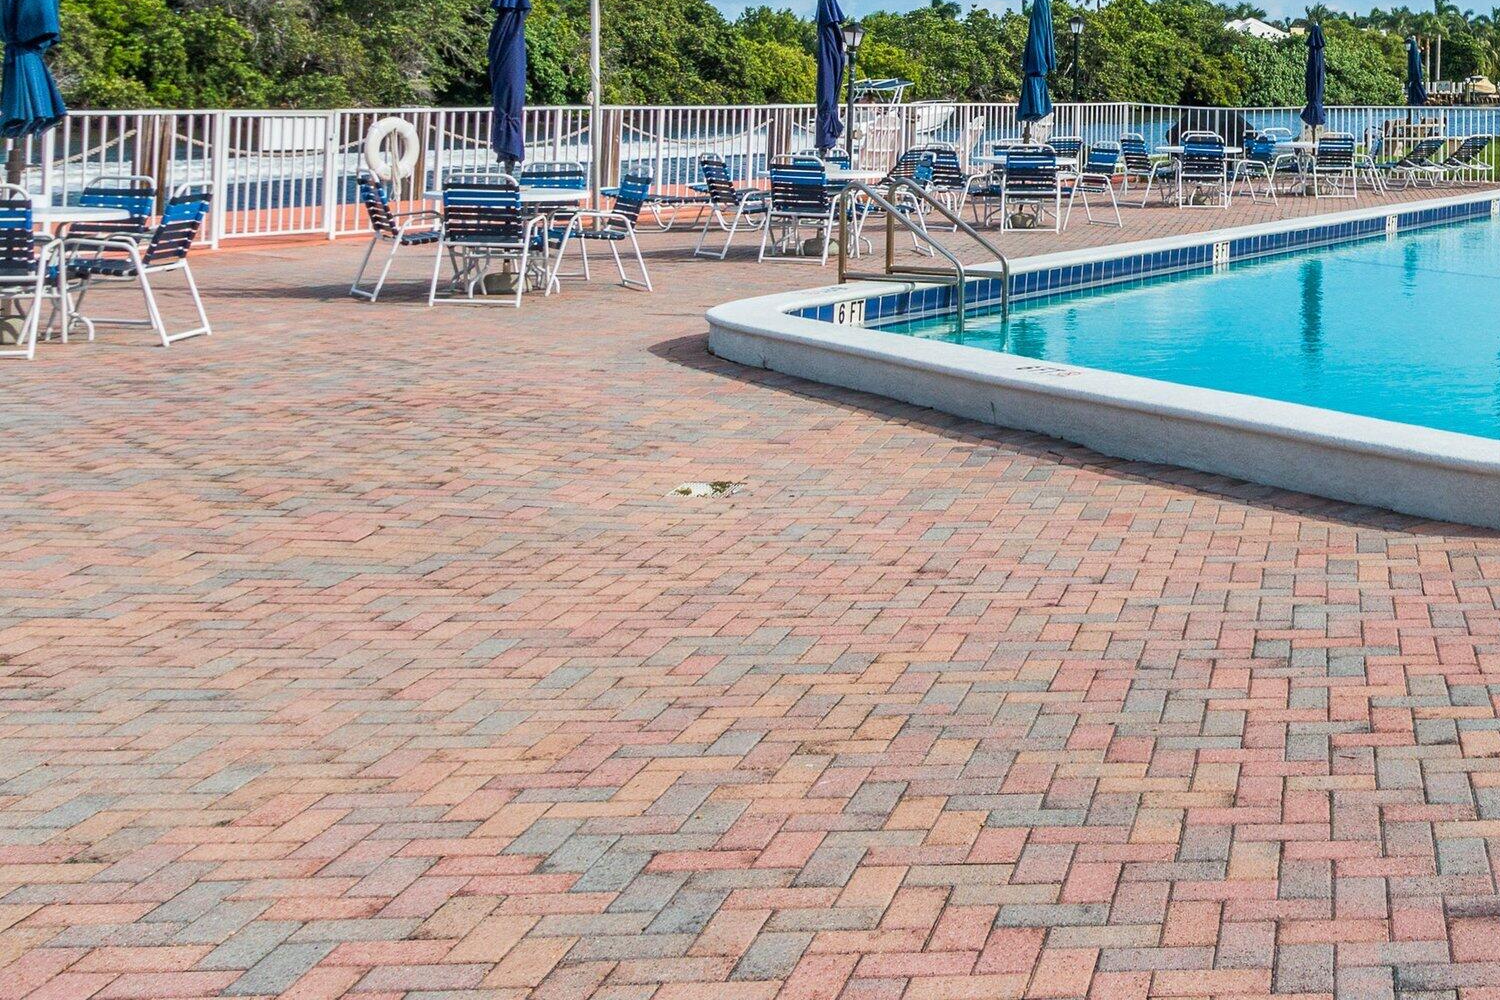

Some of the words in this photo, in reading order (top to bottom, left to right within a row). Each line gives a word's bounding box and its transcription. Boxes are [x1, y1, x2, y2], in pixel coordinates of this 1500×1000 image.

[1221, 241, 1229, 257] FT
[838, 303, 846, 325] 6
[849, 299, 865, 323] FT
